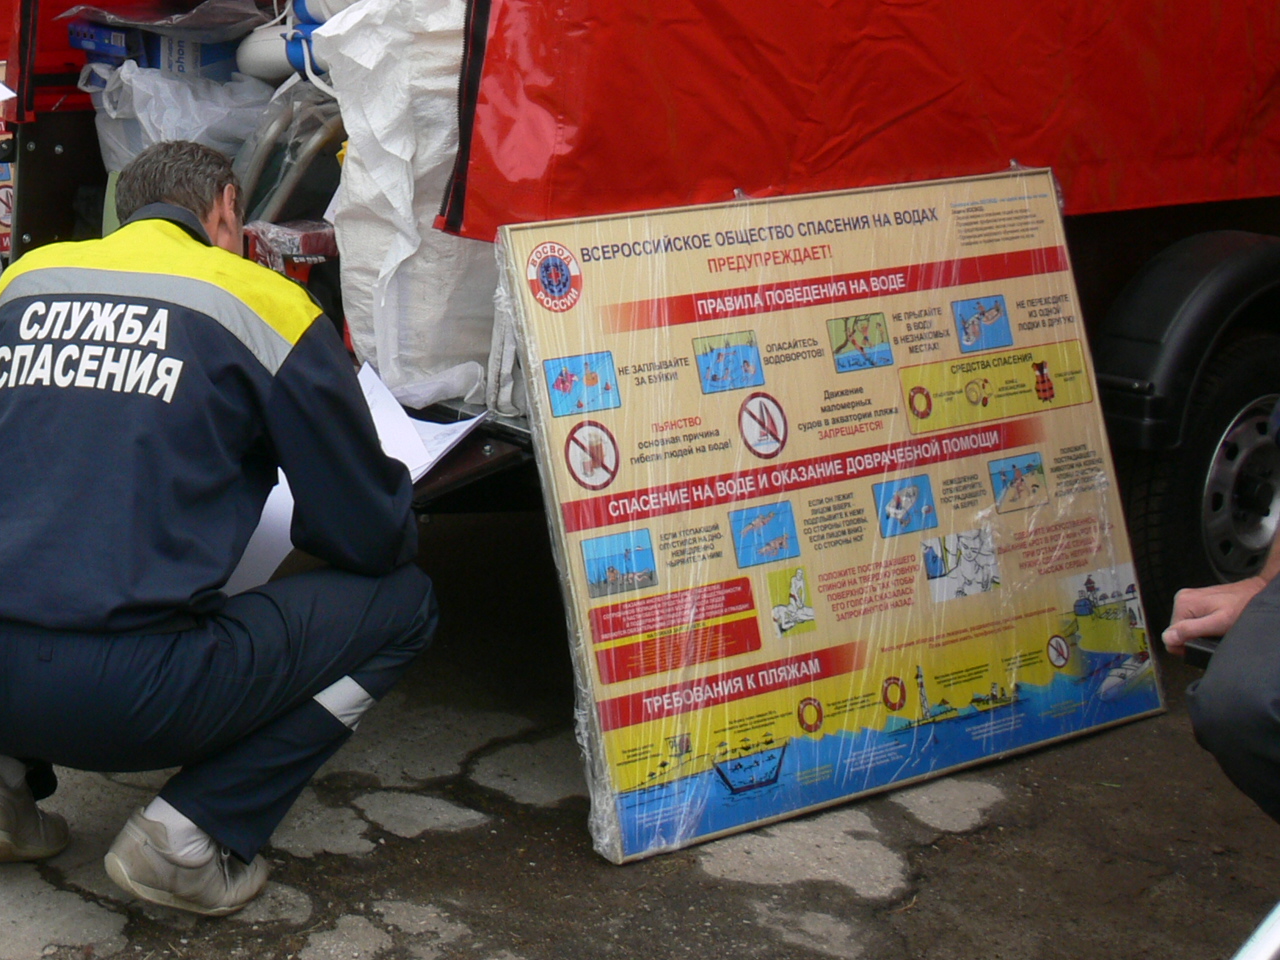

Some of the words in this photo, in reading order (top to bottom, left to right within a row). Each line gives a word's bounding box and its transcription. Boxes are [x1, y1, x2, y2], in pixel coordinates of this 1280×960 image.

[2, 237, 10, 247] И
[581, 232, 712, 263] ВСЕРОССИЙСКОЕ
[715, 222, 795, 247] ОБЩЕСТВО
[797, 213, 871, 237] СПАСЕНИЯ
[872, 210, 892, 227] НА
[895, 207, 938, 226] ВОДАХ
[530, 247, 573, 268] ВОСВОД
[708, 244, 832, 274] ПРЕДУПРЕЖДАЕТ!
[536, 287, 580, 311] РОССИИ
[697, 293, 761, 316] ПРАВИЛА
[766, 279, 846, 306] ПОВЕДЕНИЯ
[849, 276, 870, 294] НА
[870, 273, 906, 293] ВОДЕ
[1016, 300, 1026, 309] НЕ
[1027, 293, 1069, 308] ПЕРЕХОДИТЕ
[892, 312, 903, 322] НЕ
[905, 306, 942, 320] ПРЫГАЙТЕ
[1028, 309, 1037, 318] ИЗ
[1039, 305, 1062, 317] ОДНОЙ
[19, 301, 169, 350] СЛУЖБА
[913, 319, 932, 330] ВОДУ
[901, 329, 951, 344] НЕЗНАКОМЫХ
[766, 338, 819, 353] ОПАСАЙТЕСЬ
[909, 341, 940, 354] МЕСТАХ!
[763, 349, 825, 366] ВОДОВОРОТОВ!
[951, 360, 992, 374] СРЕДСТВА
[992, 353, 1033, 367] СПАСЕНИЯ
[619, 366, 631, 376] НЕ
[632, 357, 690, 374] ЗАПЛЫВАЙТЕ
[635, 377, 646, 386] ЗА
[648, 371, 679, 385] БУЙКИ!
[824, 386, 864, 401] Движение
[821, 398, 872, 413] маломерных
[651, 416, 702, 433] ПЬЯНСТВО
[798, 417, 823, 432] судов
[832, 411, 873, 426] акватории
[874, 406, 899, 418] пляжа
[818, 420, 884, 441] ЗАПРЕЩАЕТСЯ!
[638, 436, 680, 450] основная
[683, 428, 720, 444] причина
[630, 451, 663, 465] гибели
[664, 446, 694, 460] людей
[696, 445, 706, 454] на
[708, 438, 732, 452] воде!
[608, 488, 690, 517] СПАСЕНИЕ
[693, 483, 714, 502] НА
[716, 476, 756, 498] ВОДЕ
[758, 473, 770, 489] И
[771, 461, 844, 487] ОКАЗАНИЕ
[845, 444, 939, 475] ДОВРАЧЕБНОЙ
[942, 430, 1000, 456] ПОМОЩИ
[808, 498, 823, 507] ЕСЛИ
[849, 508, 864, 516] НЕМУ
[803, 527, 812, 535] СО
[813, 521, 842, 533] СТОРОНЫ
[809, 533, 825, 543] ЕСЛИ
[826, 529, 846, 539] ЛИЦОМ
[659, 537, 697, 550] ОПСТИЛСЯ
[814, 543, 823, 551] СО
[823, 536, 852, 549] СТОРОНЫ
[853, 534, 864, 542] НОГ
[818, 567, 856, 582] ПОЛОЖИТЕ
[857, 554, 916, 574] ПОСТРАДАВШЕГО
[818, 580, 846, 593] СПИНОЙ
[848, 578, 857, 587] НА
[832, 602, 845, 612] ЕГО
[643, 676, 744, 714] ТРЕБОВАНИЯ
[746, 673, 756, 687] К
[758, 658, 821, 685] ПЛЯЖАМ
